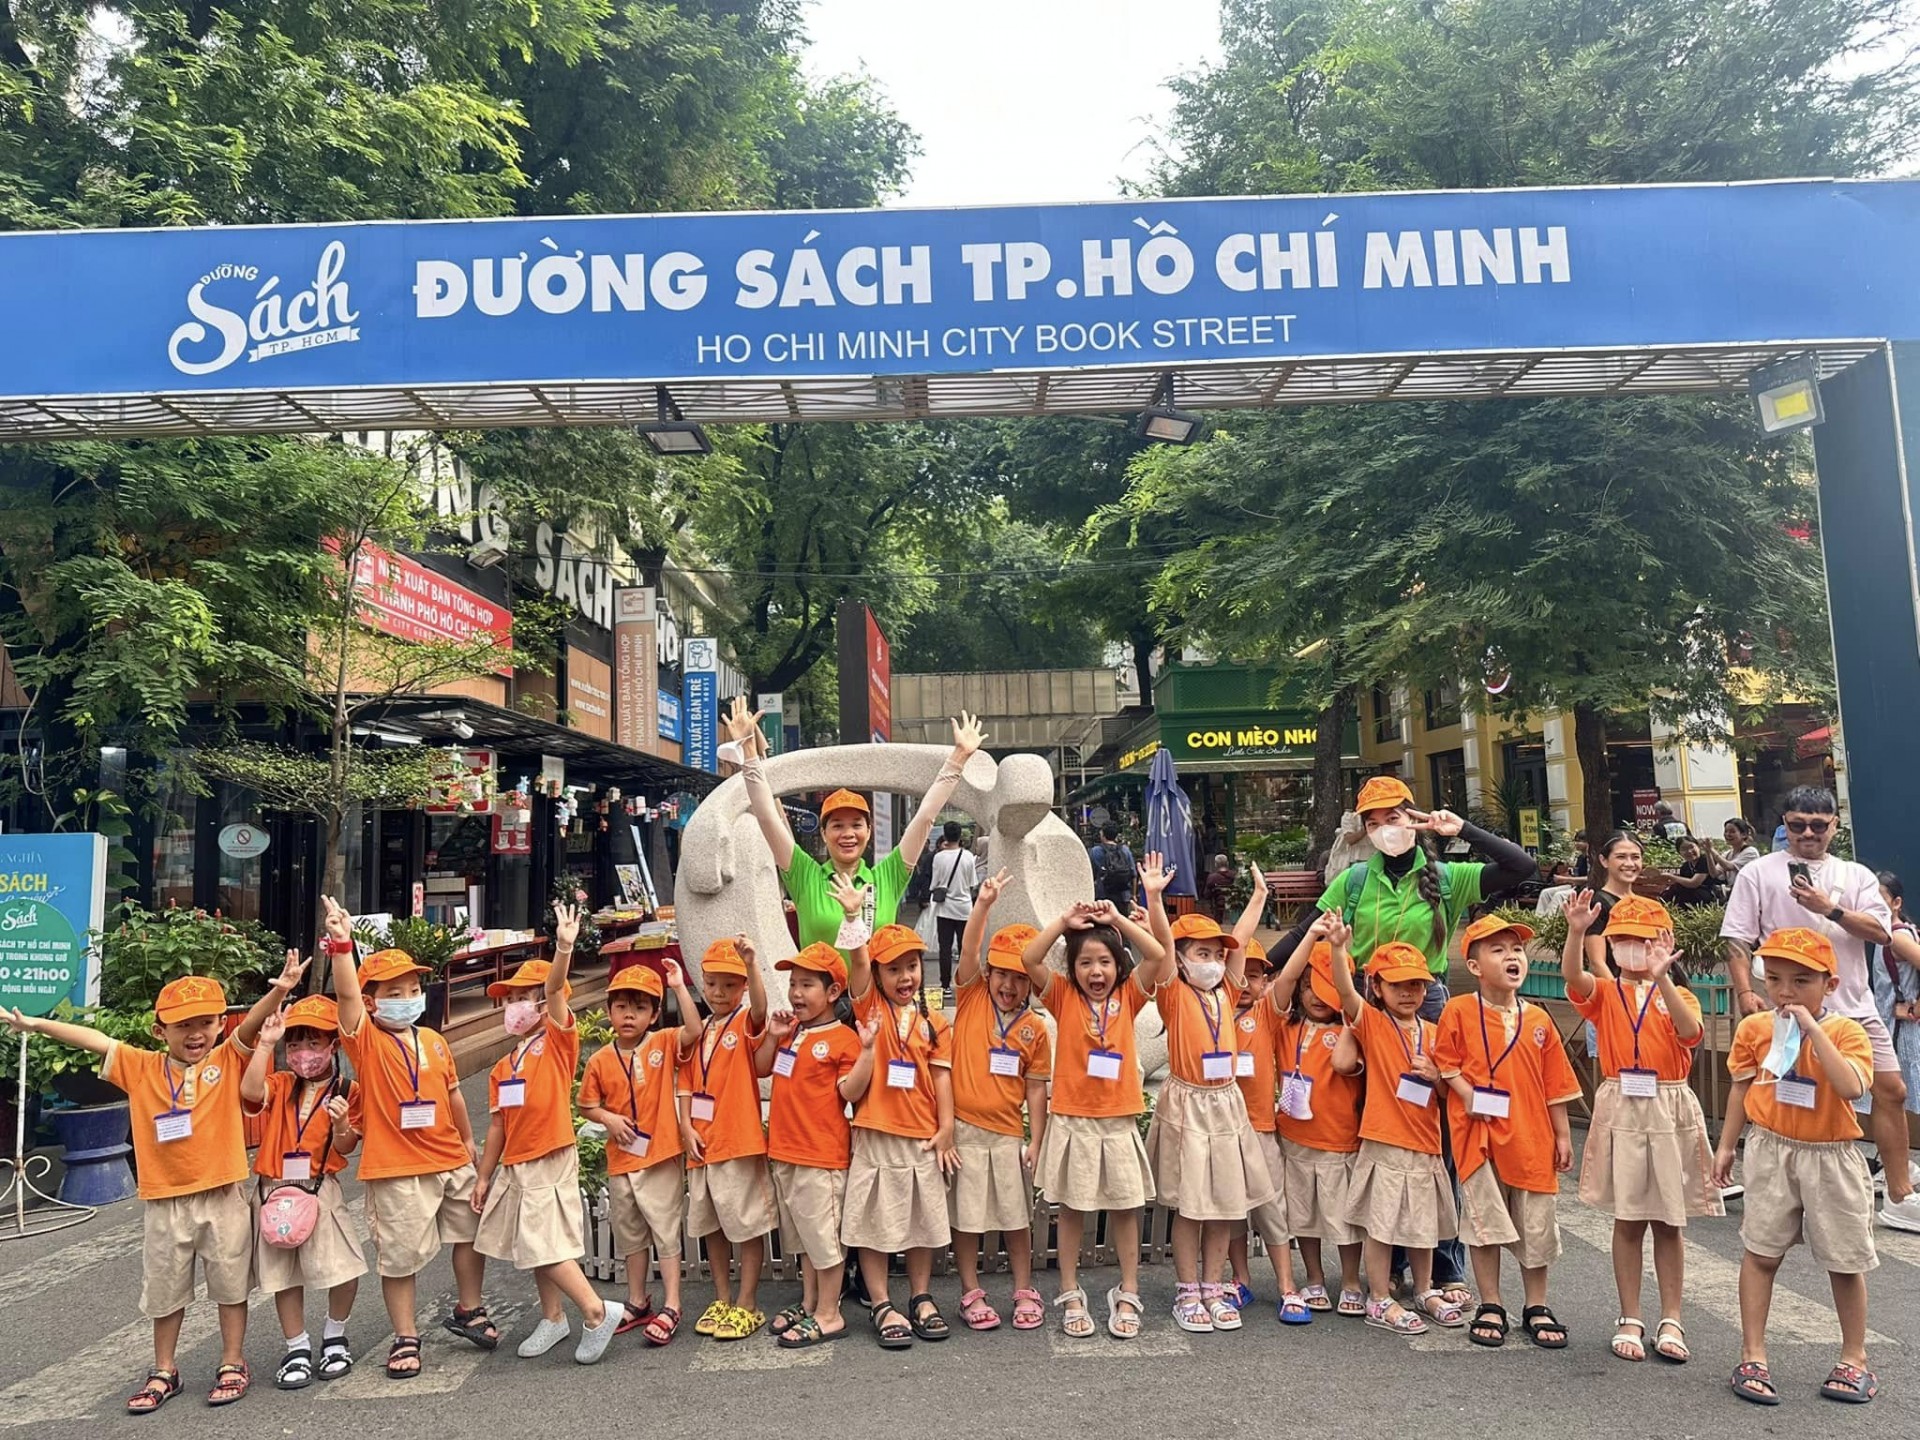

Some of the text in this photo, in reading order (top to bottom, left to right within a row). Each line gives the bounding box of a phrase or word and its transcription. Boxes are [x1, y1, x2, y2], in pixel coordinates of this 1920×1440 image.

[412, 235, 708, 318] ĐƯỜNG
[734, 229, 932, 310] SÁCH
[1214, 211, 1340, 292] CHÍ
[1363, 225, 1572, 289] MINH
[168, 240, 361, 376] Sách
[302, 331, 339, 347] HCM
[697, 314, 1298, 363] HO CHI MINH CITY BOOK STREET
[1187, 730, 1232, 748] CON
[1237, 725, 1279, 747] MÈO
[1636, 804, 1657, 816] NOW
[22, 966, 71, 982] 21h00
